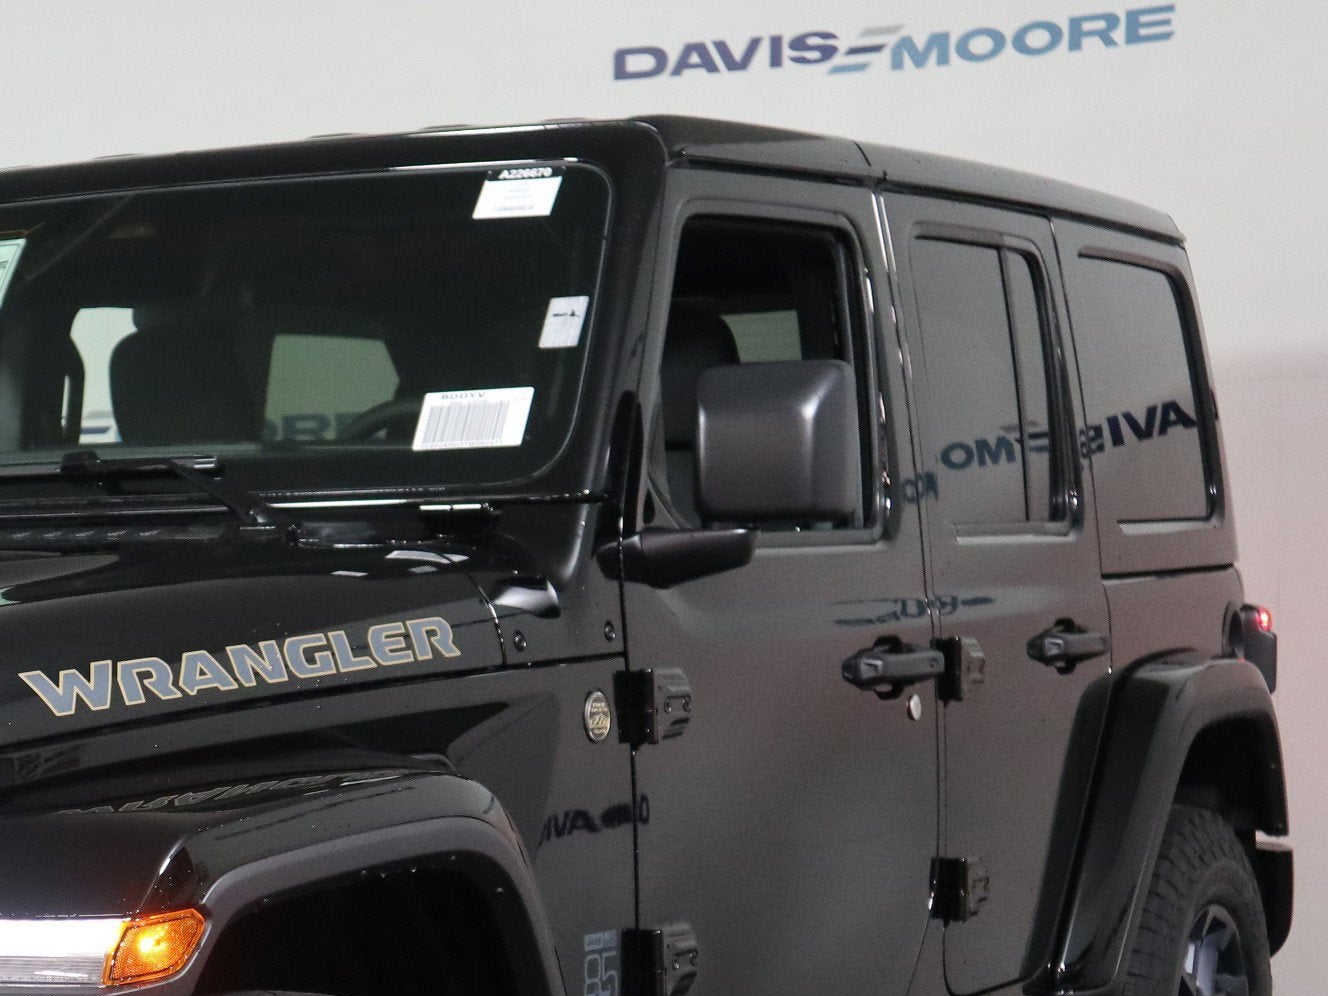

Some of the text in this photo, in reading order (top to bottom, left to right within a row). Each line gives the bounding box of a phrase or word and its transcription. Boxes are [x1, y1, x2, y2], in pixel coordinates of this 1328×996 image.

[612, 5, 1175, 80] DAVIS MOORE
[18, 616, 461, 716] WRANGLER
